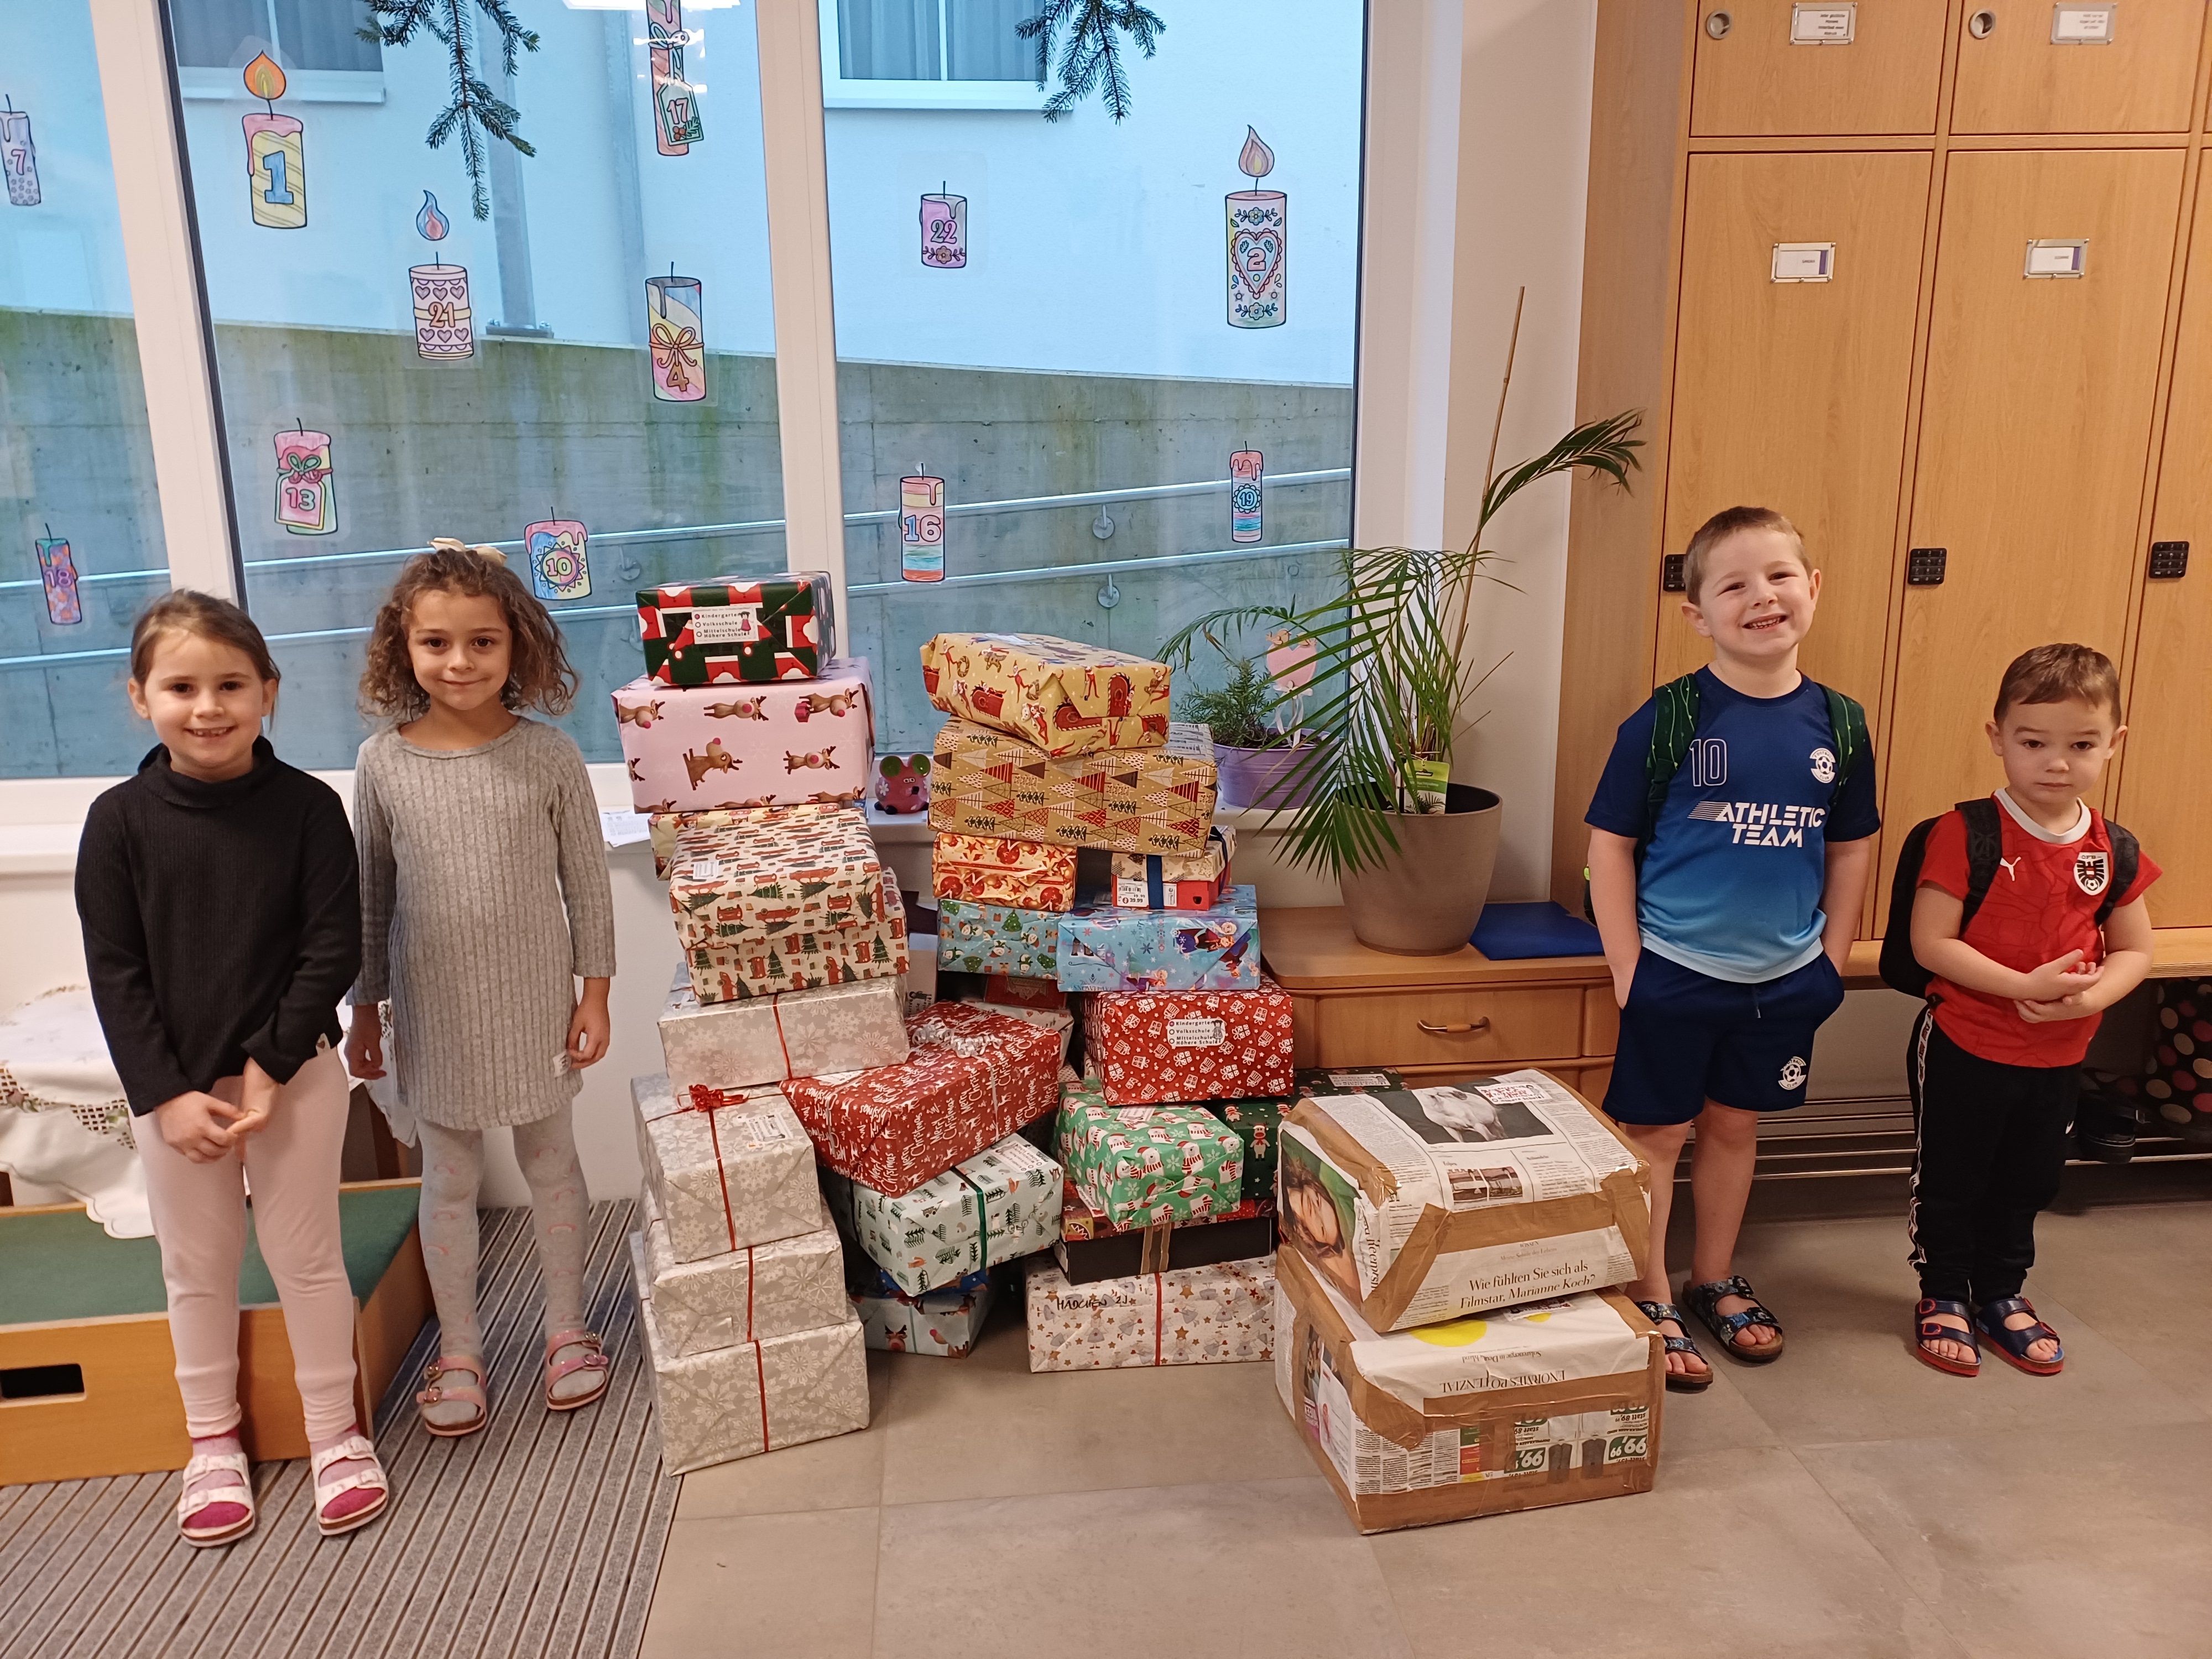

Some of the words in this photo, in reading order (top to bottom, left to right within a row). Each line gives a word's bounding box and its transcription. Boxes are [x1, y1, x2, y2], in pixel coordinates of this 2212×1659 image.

[666, 97, 690, 126] 17
[11, 149, 27, 176] 7
[262, 150, 294, 205] 1
[930, 219, 957, 244] 22
[1246, 247, 1266, 272] 2
[427, 302, 457, 328] 21
[666, 363, 689, 392] 4
[285, 487, 316, 512] 13
[1239, 491, 1254, 507] 19
[904, 514, 942, 542] 16
[44, 566, 72, 588] 18
[545, 556, 572, 577] 10
[1689, 738, 1727, 787] 10
[1716, 801, 1826, 828] ATHLETIC
[1731, 823, 1803, 848] TEAM
[959, 1087, 974, 1115] Merry
[1024, 1077, 1039, 1119] Christmas
[930, 1117, 945, 1145] Merry
[942, 1097, 957, 1140] Christmas
[910, 1112, 926, 1156] Christmas
[868, 1156, 884, 1183] Merry
[901, 1143, 916, 1171] Merry
[880, 1152, 899, 1192] Christmas
[1469, 1277, 1491, 1292] Wie
[1493, 1272, 1531, 1288] fühlten
[1532, 1267, 1550, 1281] Sie
[1551, 1262, 1572, 1277] sich
[1573, 1259, 1589, 1273] als
[1460, 1294, 1506, 1309] Filmstar,
[1508, 1284, 1561, 1300] Marianne
[1561, 1274, 1596, 1290] Koch?
[1506, 1350, 1542, 1360] Solarenergie
[1439, 1376, 1508, 1394] POTENZIAL
[1509, 1370, 1566, 1386] ENORMES
